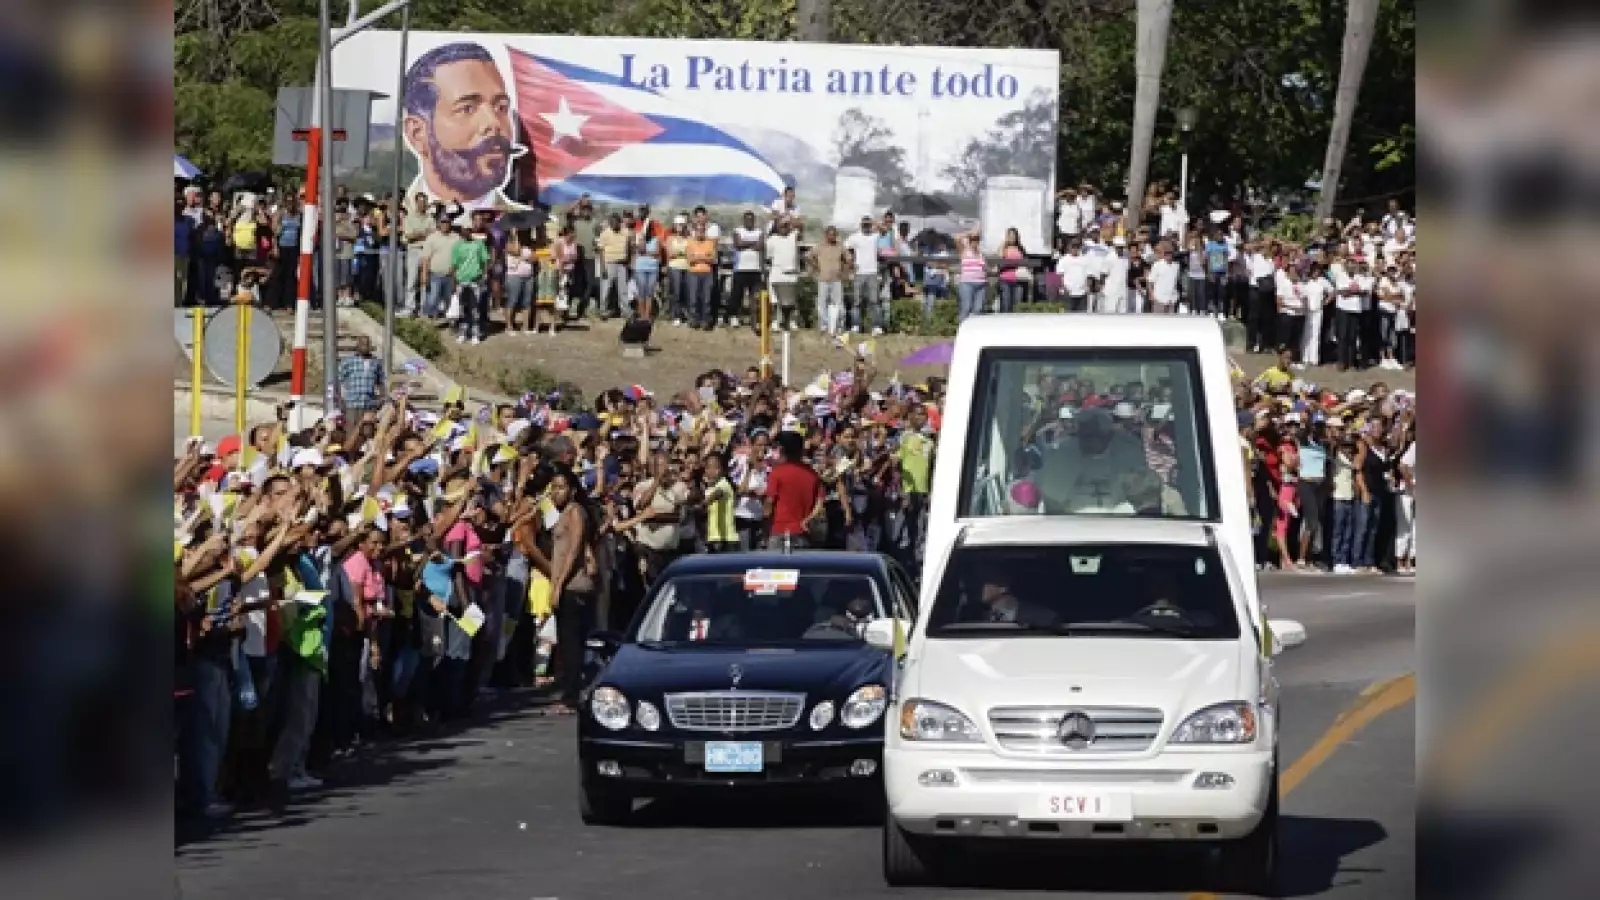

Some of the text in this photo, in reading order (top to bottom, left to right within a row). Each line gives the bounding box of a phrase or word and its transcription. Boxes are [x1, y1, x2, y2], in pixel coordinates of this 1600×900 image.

[620, 53, 1019, 99] La Patria ante todo
[1049, 796, 1087, 814] SCV
